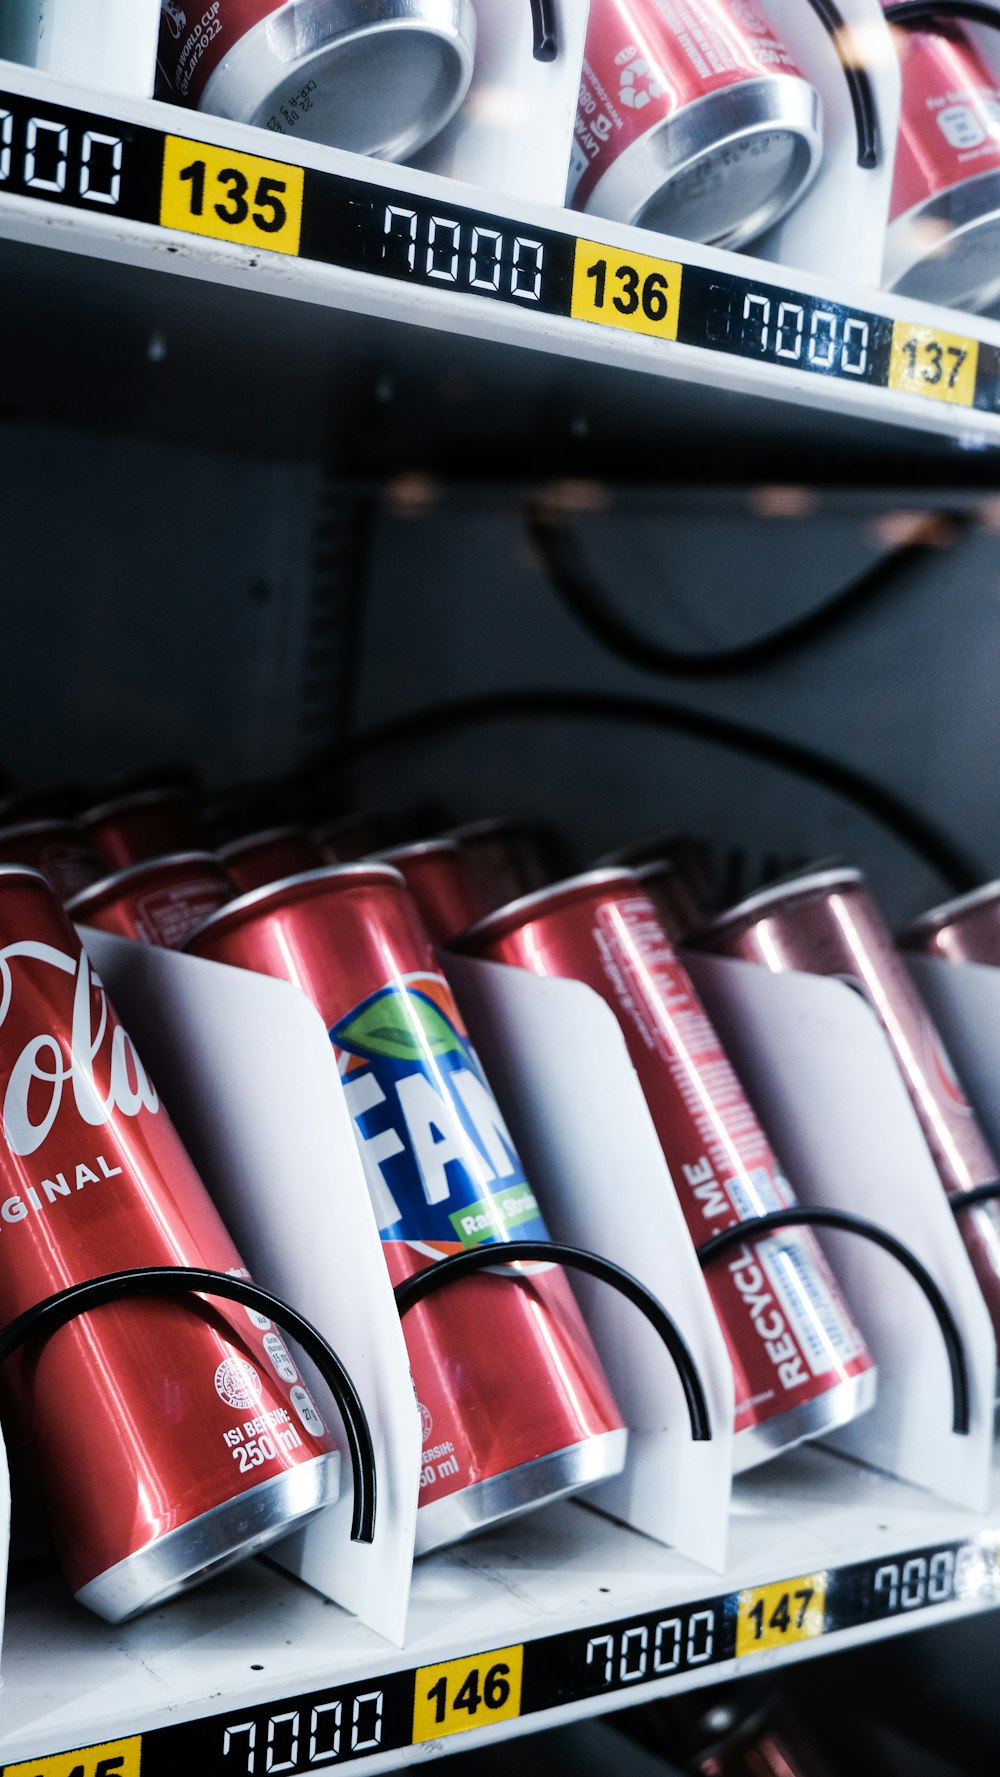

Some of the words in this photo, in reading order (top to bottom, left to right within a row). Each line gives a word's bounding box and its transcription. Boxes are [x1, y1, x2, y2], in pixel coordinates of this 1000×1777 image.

[179, 24, 203, 68] WORLD
[201, 2, 221, 26] CUP
[579, 83, 597, 114] 080
[0, 110, 123, 204] 00
[179, 160, 288, 234] 135
[384, 204, 544, 301] 7000
[586, 259, 669, 322] 136
[743, 293, 869, 376] 7000
[901, 337, 968, 390] 137
[0, 940, 160, 1156] ola
[342, 1068, 516, 1231] FAN
[0, 1156, 122, 1231] GINAL
[682, 1156, 730, 1219] ME
[712, 1220, 810, 1389] RECYCL
[223, 1427, 245, 1448] ISI
[243, 1407, 291, 1438] BERSIH:
[232, 1435, 277, 1474] 250
[279, 1423, 303, 1451] ml
[421, 1441, 455, 1464] ERSIH:
[419, 1465, 437, 1488] 50
[437, 1454, 460, 1478] ml
[586, 1609, 714, 1685] 7000
[747, 1588, 816, 1641] 147
[426, 1664, 511, 1723] 146
[222, 1690, 385, 1774] 7000
